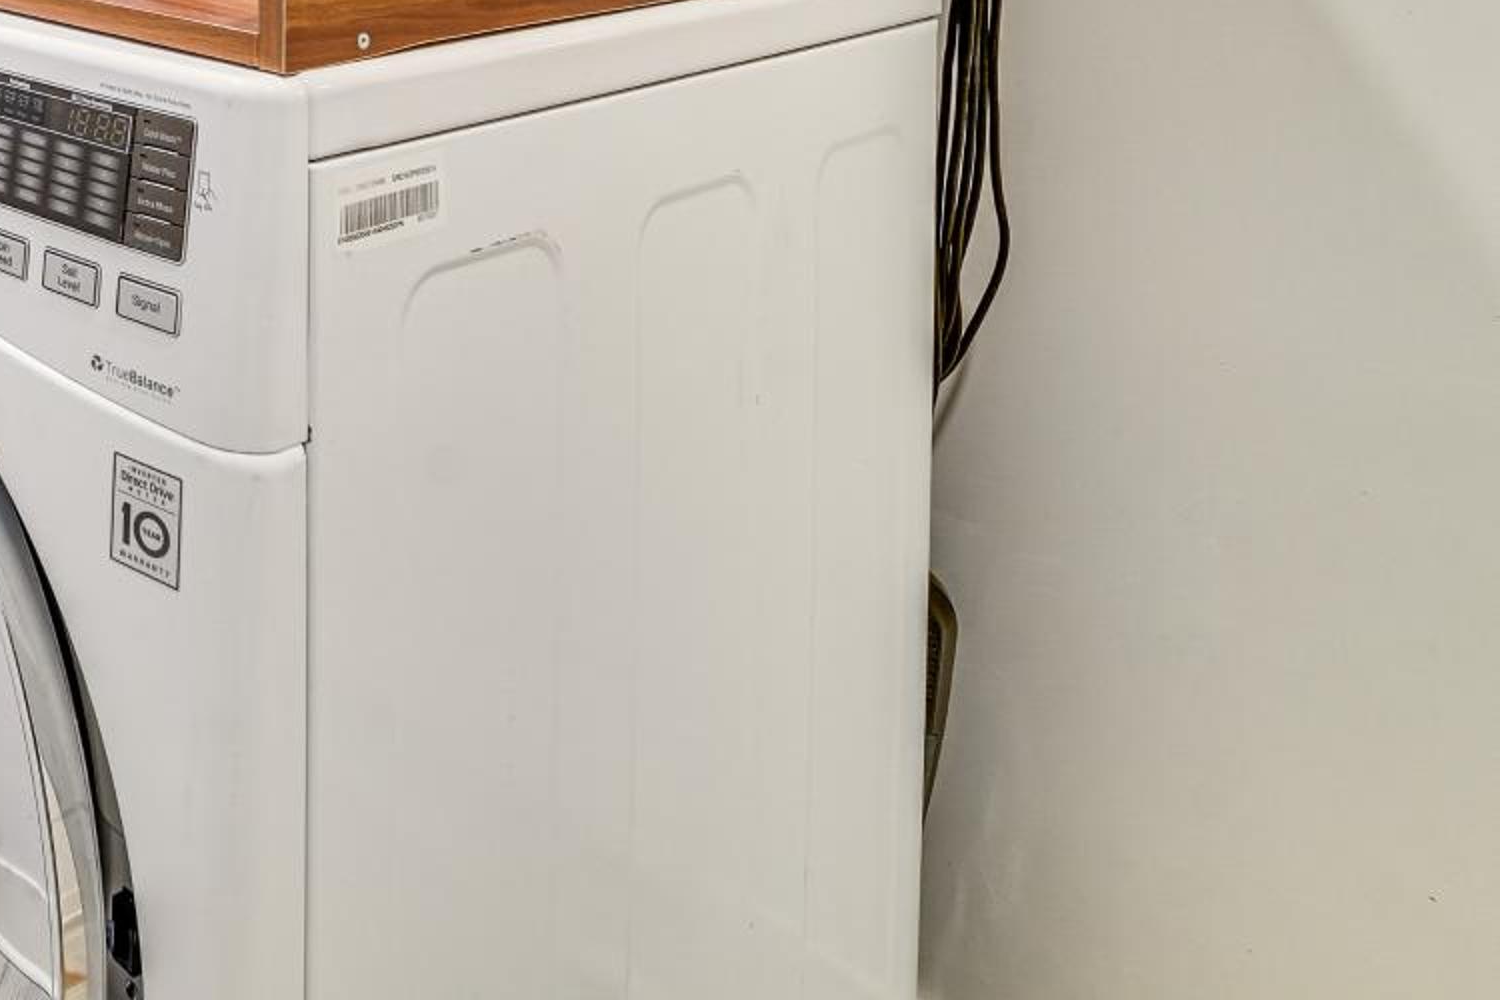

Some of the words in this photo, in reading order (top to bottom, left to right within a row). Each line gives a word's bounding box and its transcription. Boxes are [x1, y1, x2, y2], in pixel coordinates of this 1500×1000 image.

[57, 275, 81, 293] Level
[131, 294, 161, 313] Signal
[120, 468, 148, 490] Direct
[149, 481, 174, 502] Drive
[121, 501, 171, 558] 10
